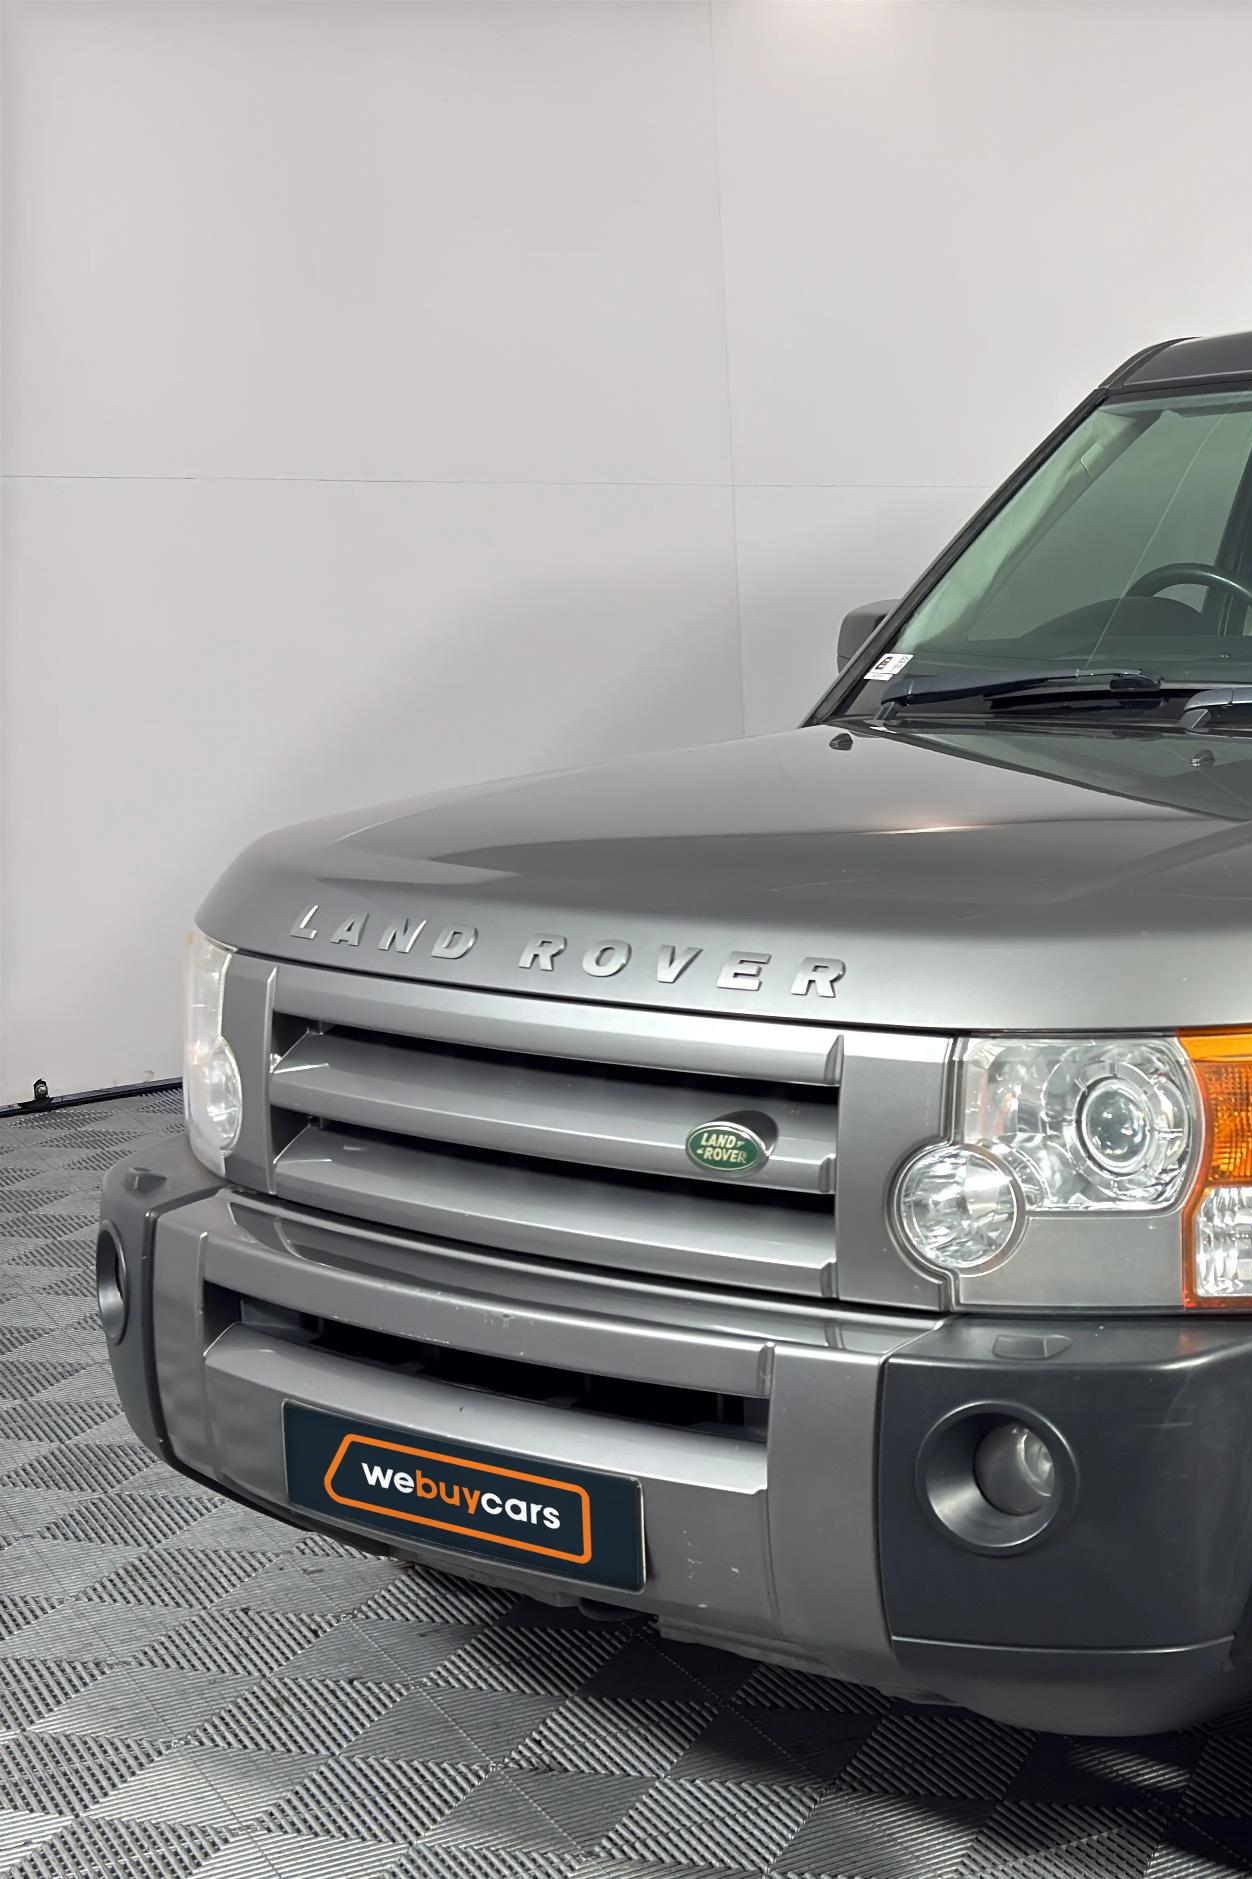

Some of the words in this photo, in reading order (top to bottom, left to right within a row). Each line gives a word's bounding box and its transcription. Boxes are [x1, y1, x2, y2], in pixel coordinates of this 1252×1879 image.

[290, 904, 479, 960] LAND
[518, 931, 846, 998] ROVER
[700, 1132, 737, 1149] LAND
[703, 1147, 748, 1164] ROVER
[361, 1462, 561, 1530] webuycars
